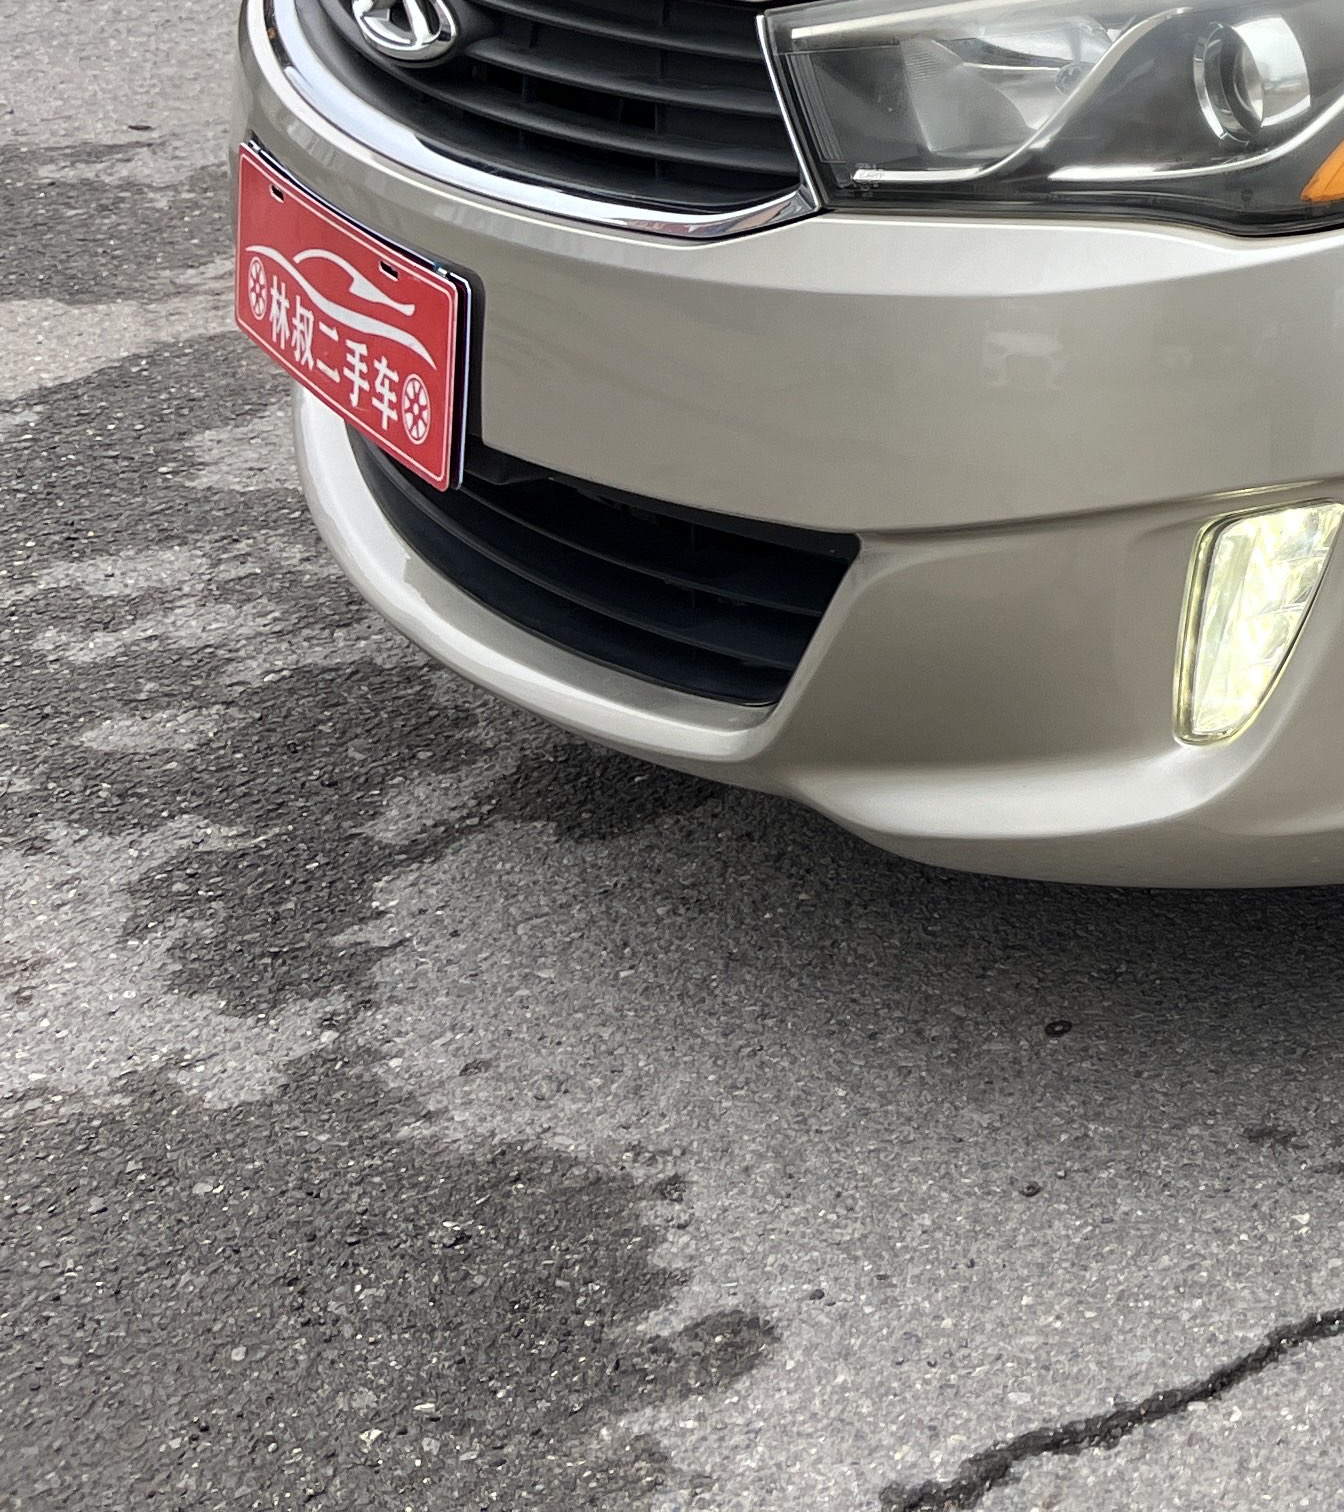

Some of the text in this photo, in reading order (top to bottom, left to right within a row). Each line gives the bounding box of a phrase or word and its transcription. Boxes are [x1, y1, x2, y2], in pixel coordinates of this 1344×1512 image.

[269, 275, 399, 431] 林叔二手车
